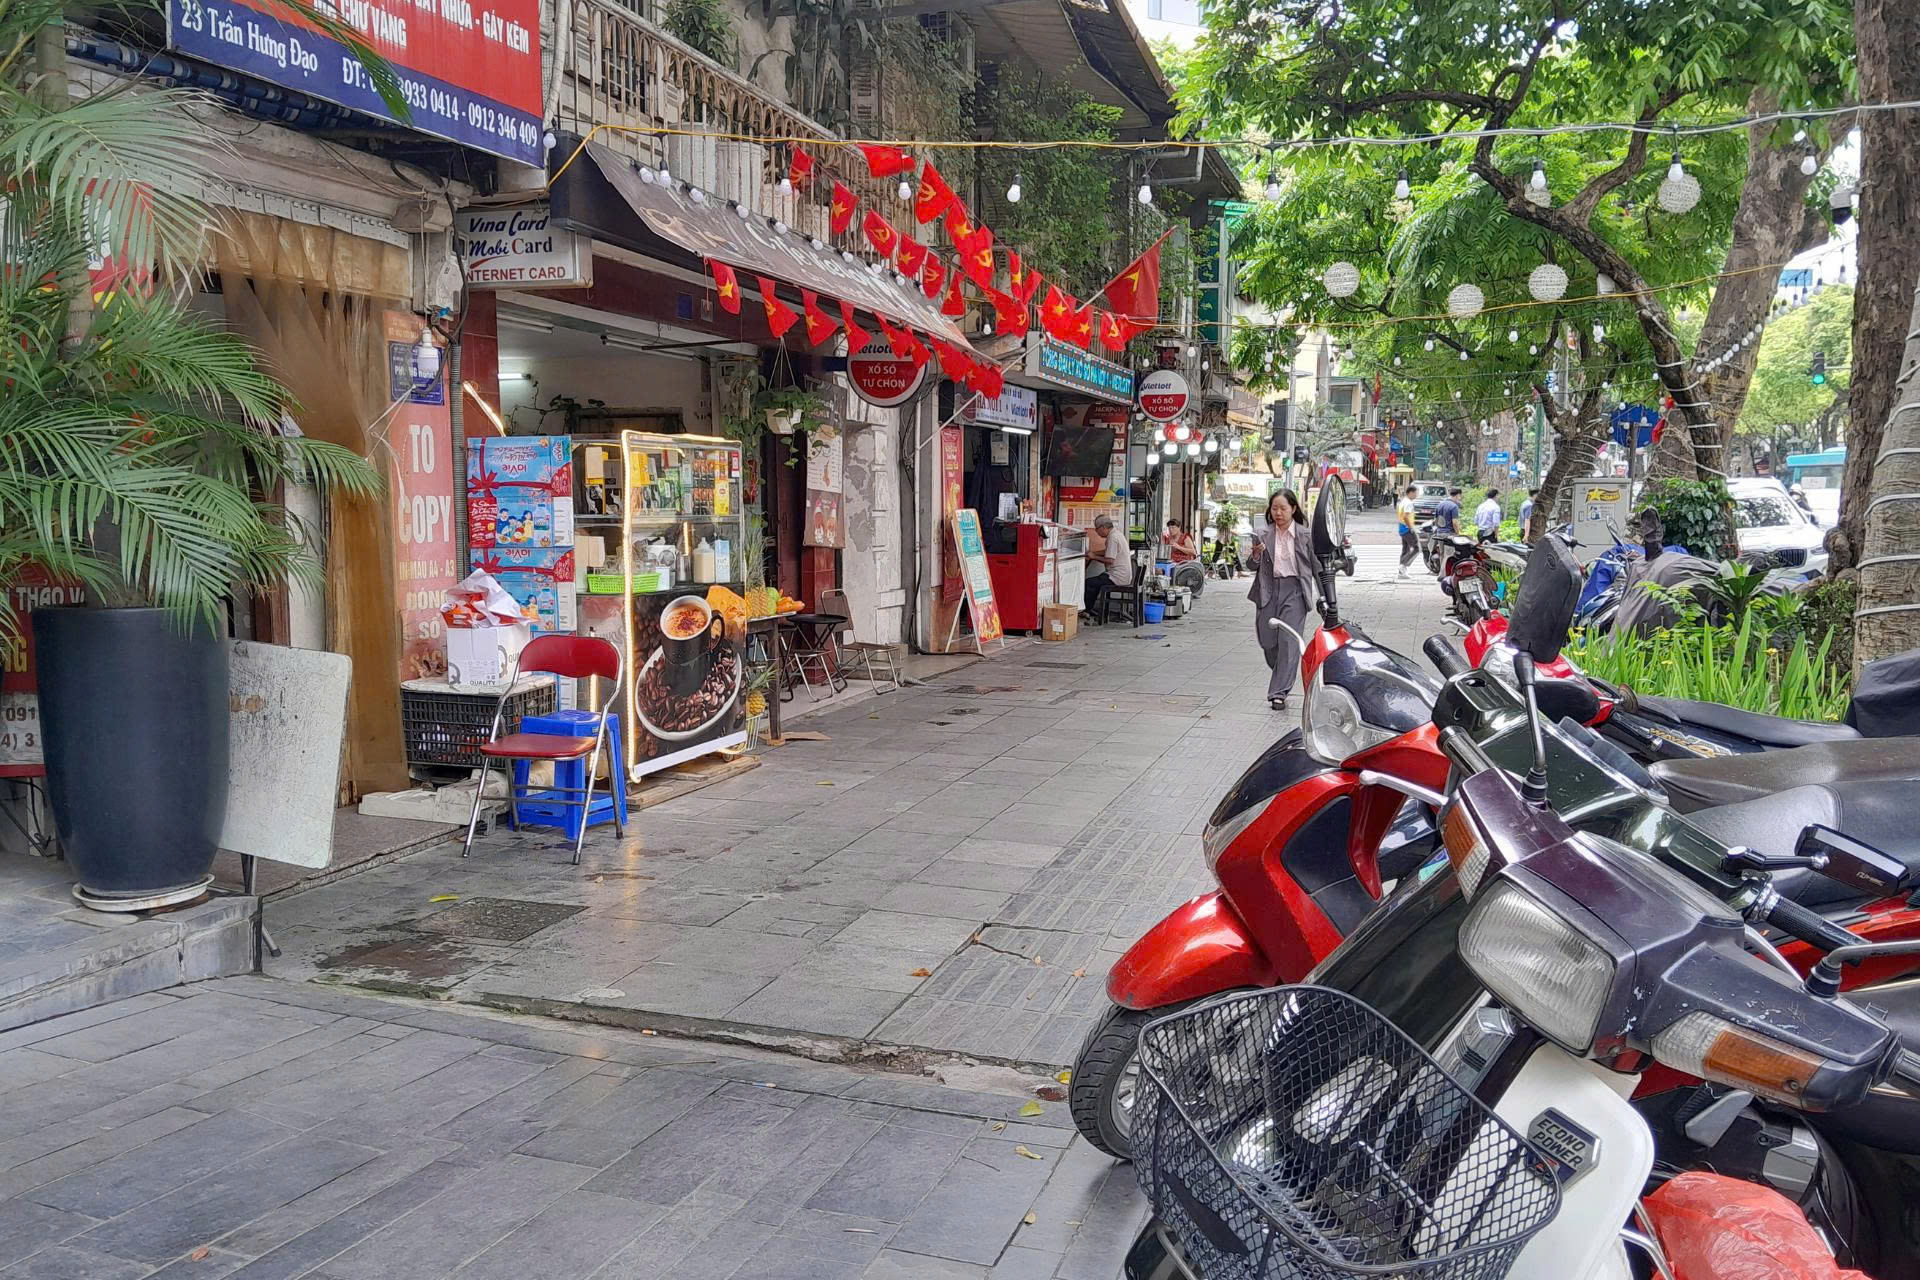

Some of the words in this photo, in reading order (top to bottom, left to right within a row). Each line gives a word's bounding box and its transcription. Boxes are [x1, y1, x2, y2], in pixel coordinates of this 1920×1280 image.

[181, 0, 203, 32] 23
[207, 7, 243, 46] Trần
[247, 21, 286, 68] Hưng
[290, 38, 318, 77] Đạo
[371, 4, 407, 48] VÀNG
[483, 10, 503, 43] GÁY
[342, 57, 366, 89] ĐT:
[430, 88, 459, 120] 0414
[468, 102, 495, 133] 0912
[498, 113, 517, 141] 346
[519, 120, 538, 147] 409
[469, 217, 507, 233] Vina
[508, 211, 550, 236] Card
[469, 239, 510, 257] Mobi
[511, 237, 553, 255] Card
[466, 267, 525, 282] NTERNET
[529, 266, 566, 279] CARD
[877, 378, 905, 389] CHỌN
[408, 424, 435, 474] TO
[398, 494, 451, 544] COPY
[1532, 1131, 1584, 1167] POWER
[1536, 1118, 1586, 1152] ECONO
